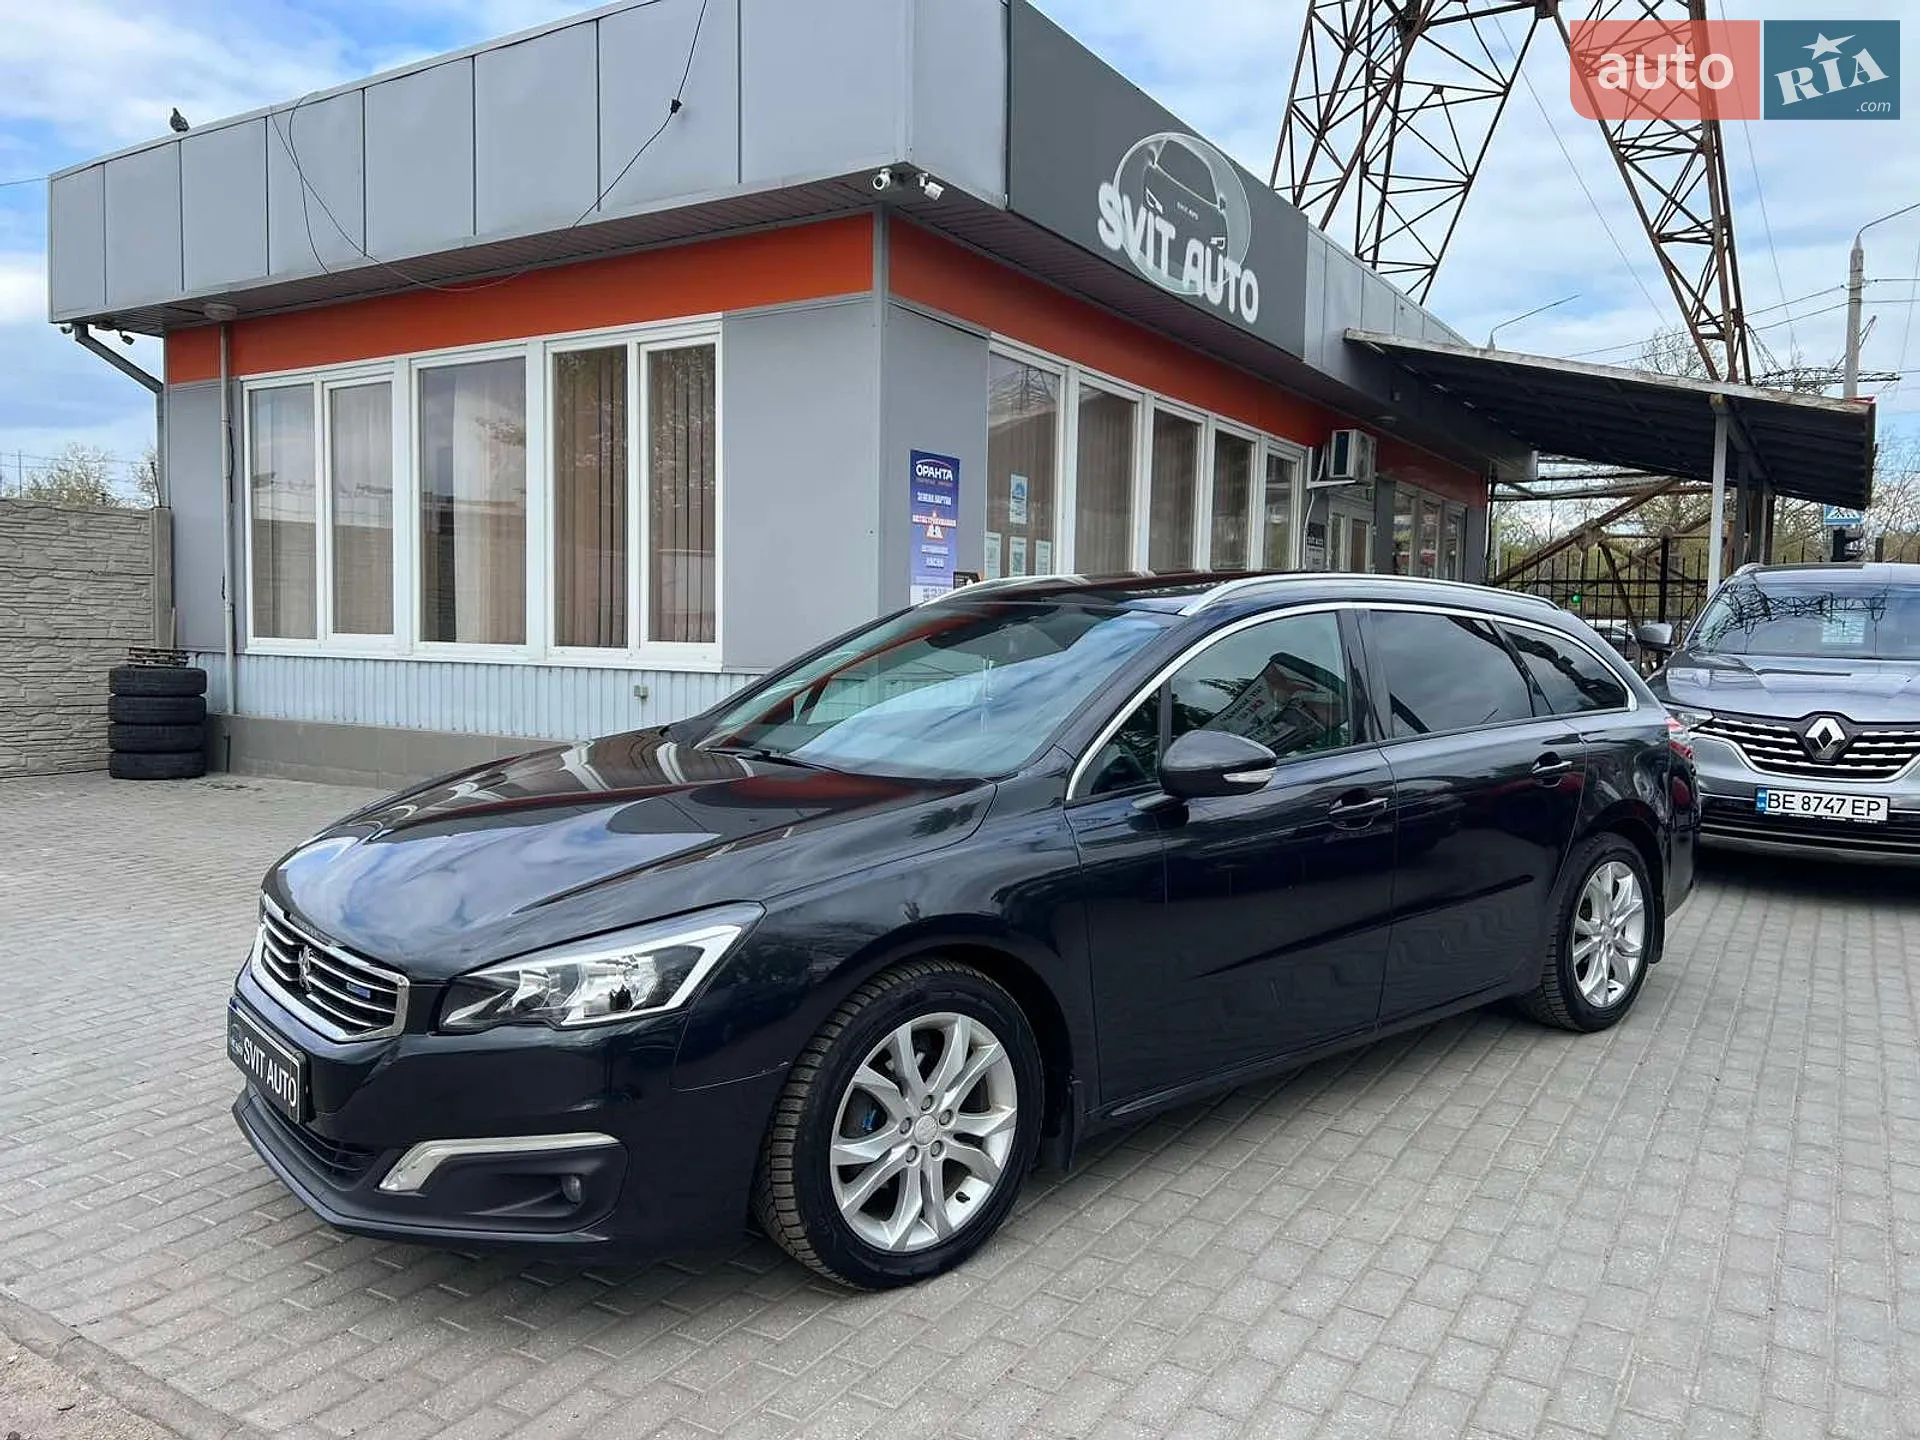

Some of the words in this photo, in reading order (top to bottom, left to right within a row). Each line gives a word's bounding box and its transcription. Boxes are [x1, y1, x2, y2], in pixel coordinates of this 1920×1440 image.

[1097, 181, 1176, 278] SVIT
[1182, 238, 1259, 325] AUTO
[915, 464, 953, 481] ОРАНТА
[1767, 793, 1795, 811] BE
[1801, 795, 1846, 814] 8747
[1851, 799, 1881, 816] EP
[243, 1037, 266, 1079] SVIT
[266, 1058, 297, 1107] AUTO
